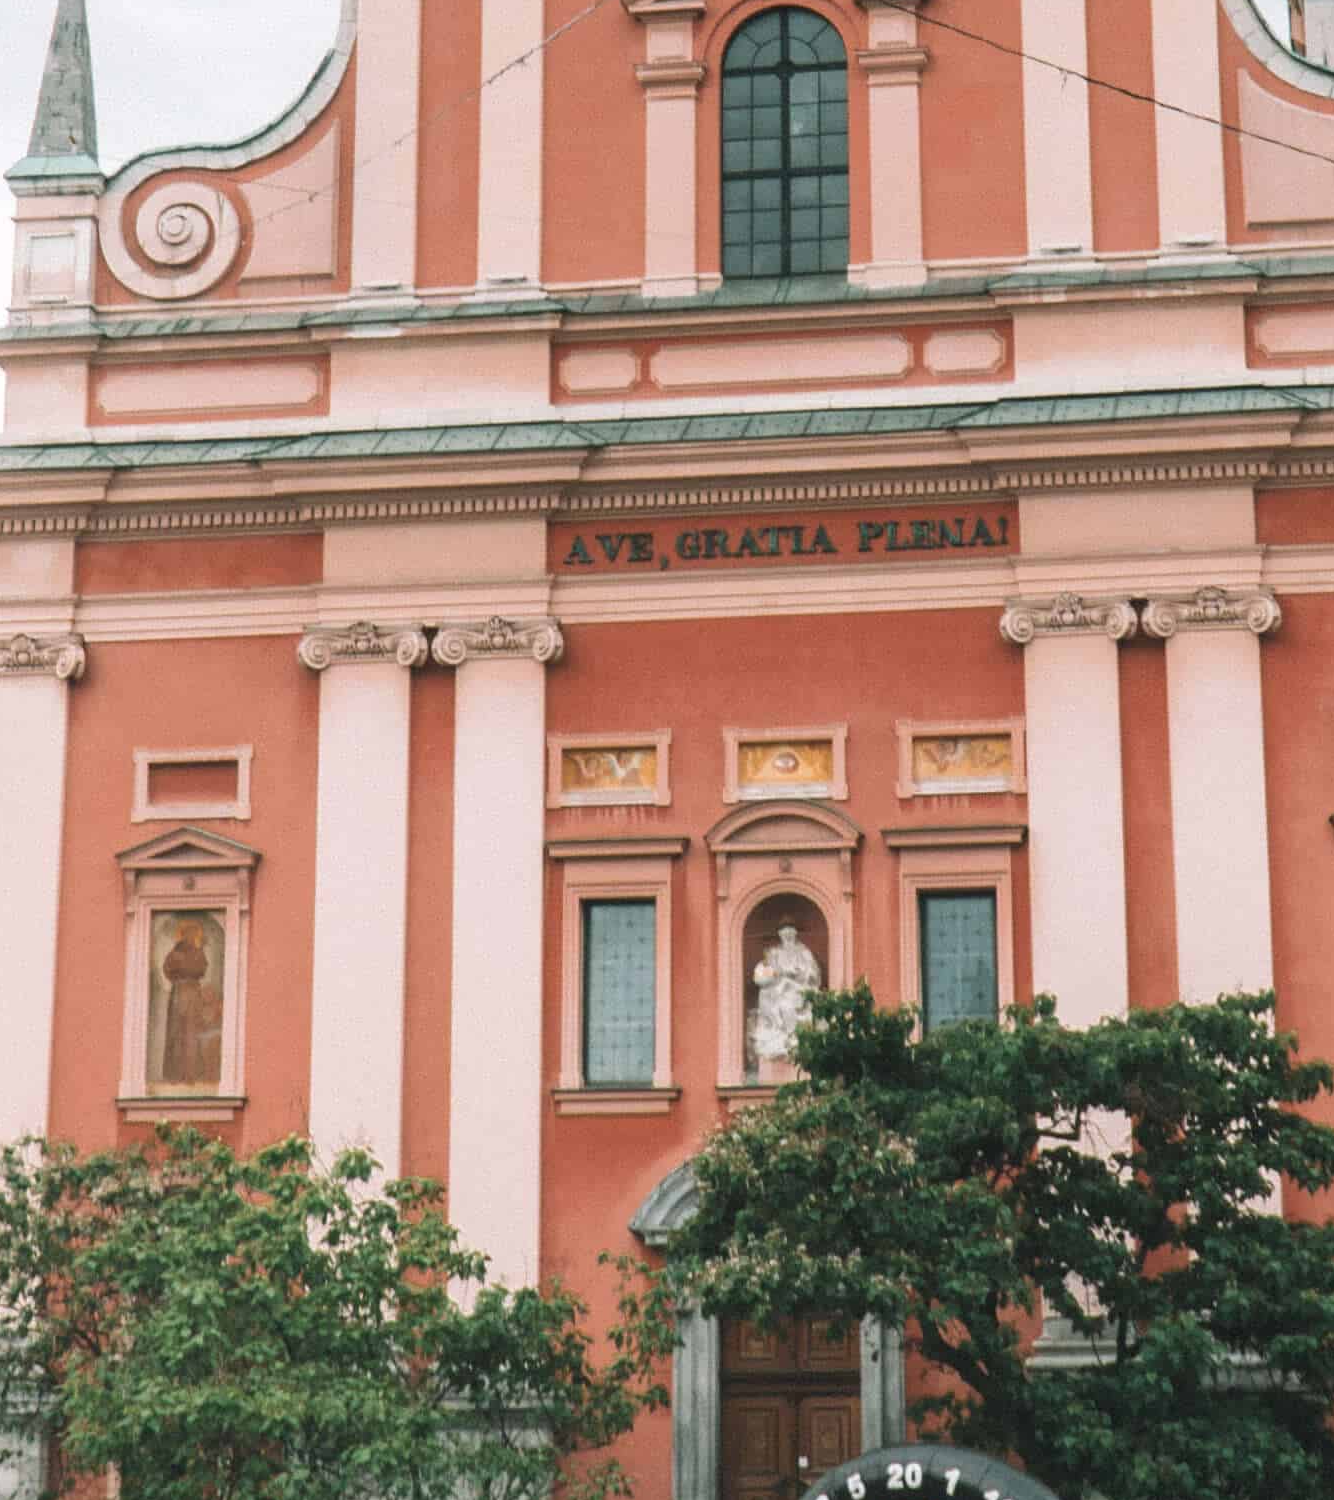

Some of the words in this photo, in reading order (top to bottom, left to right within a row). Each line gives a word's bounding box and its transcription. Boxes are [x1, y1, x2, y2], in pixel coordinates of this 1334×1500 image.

[564, 531, 670, 571] AVE,
[676, 524, 837, 560] GRATIA
[857, 515, 1010, 552] PLENA!
[846, 1473, 866, 1500] 5
[886, 1463, 923, 1489] 20
[945, 1468, 961, 1495] 1
